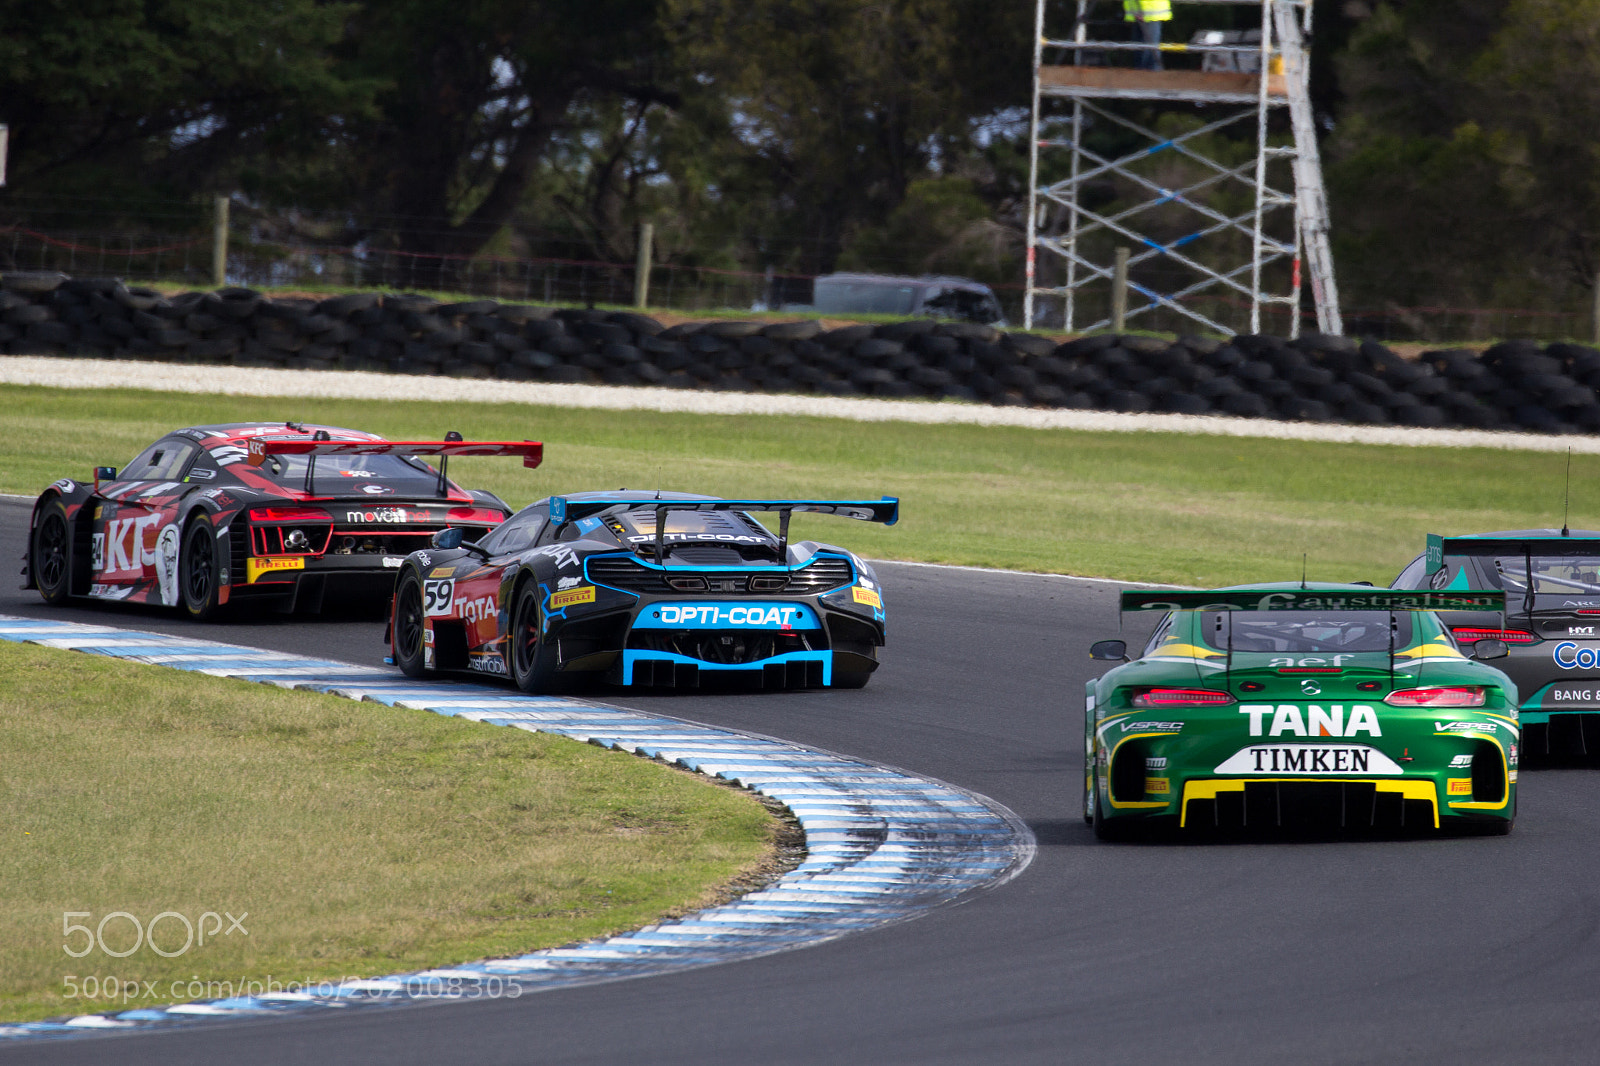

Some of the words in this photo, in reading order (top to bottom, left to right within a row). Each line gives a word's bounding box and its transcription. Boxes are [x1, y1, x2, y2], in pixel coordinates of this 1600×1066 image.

[249, 441, 264, 455] KFC
[255, 558, 304, 570] PIRELLI
[425, 581, 452, 612] 59
[553, 589, 592, 605] PIRELLI
[455, 596, 501, 624] TOTA
[660, 606, 796, 625] OPTI-COAT
[1268, 654, 1355, 667] aef
[1553, 641, 1600, 669] Co
[1554, 690, 1591, 701] BANG
[1238, 705, 1382, 737] TANA
[1250, 749, 1370, 772] TIMKEN
